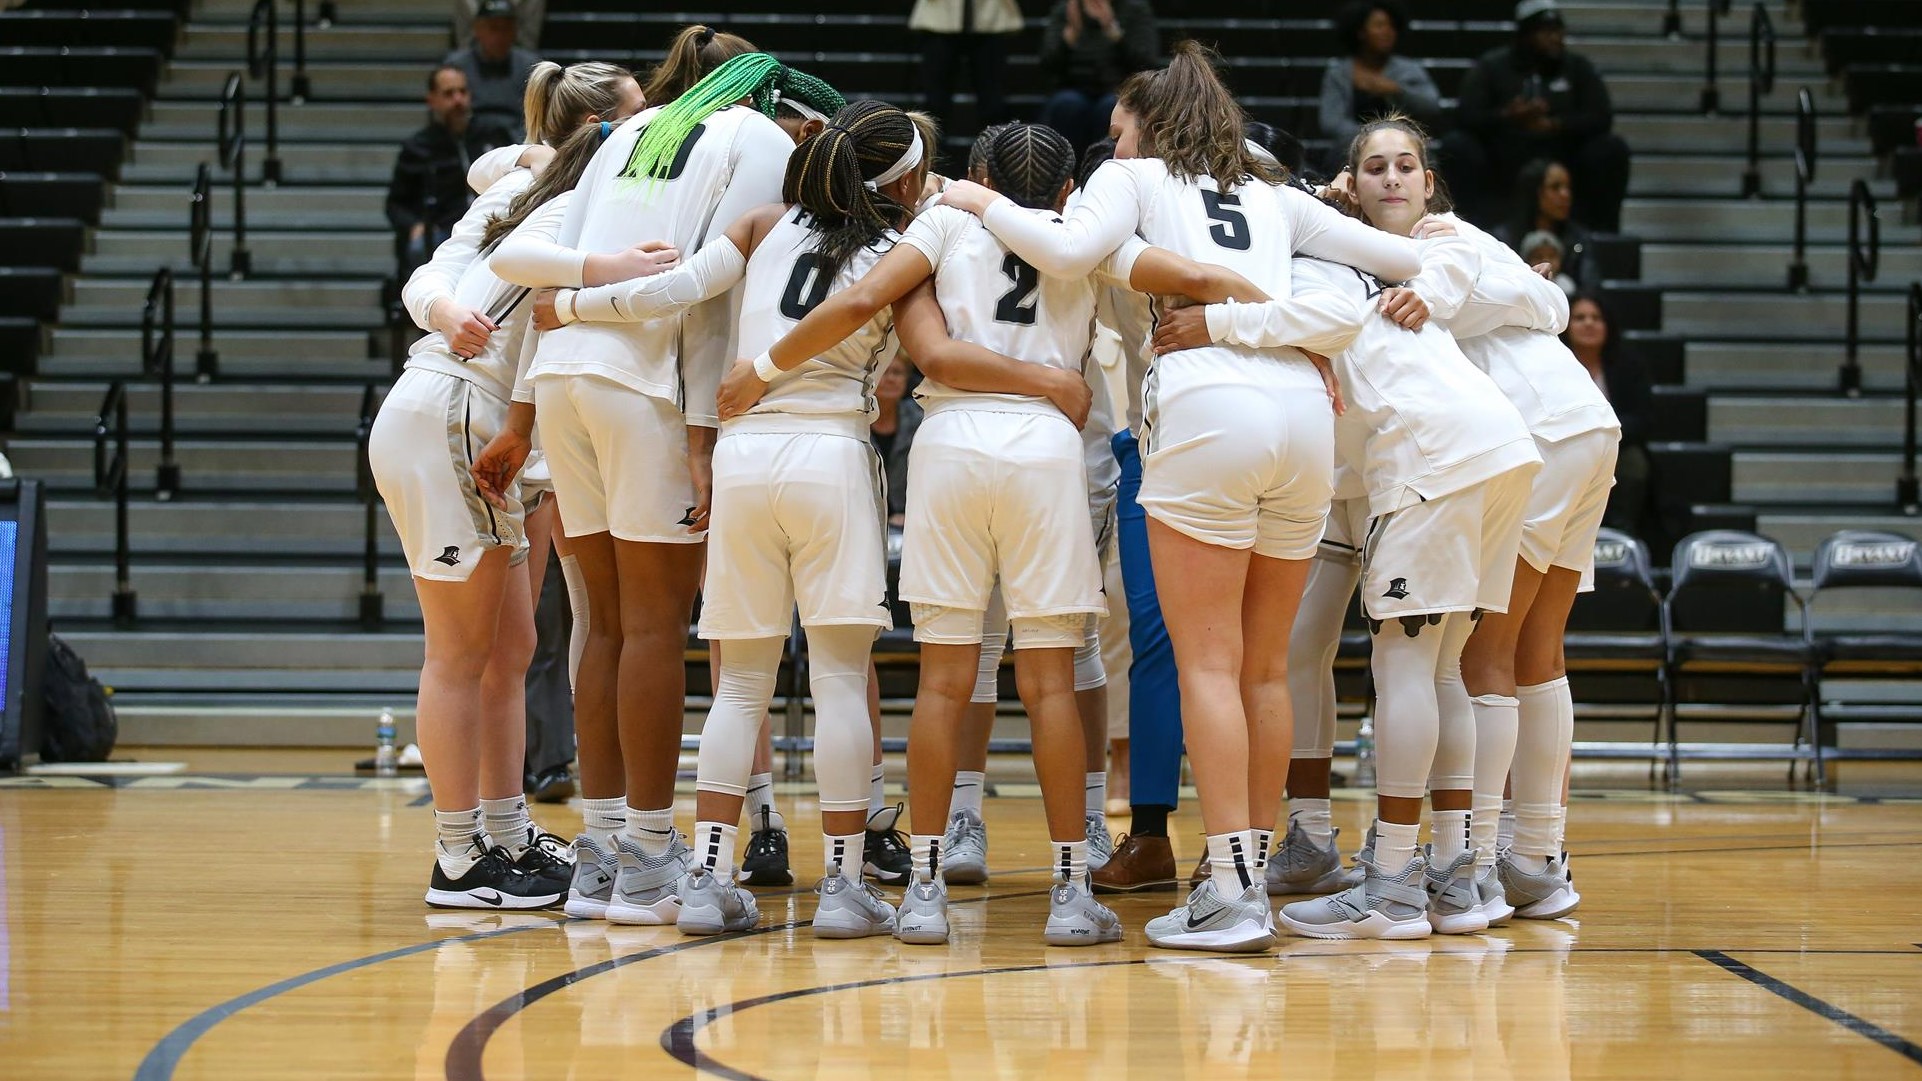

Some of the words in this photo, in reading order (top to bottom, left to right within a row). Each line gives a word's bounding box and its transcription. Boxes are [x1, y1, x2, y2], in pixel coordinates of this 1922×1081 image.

[1200, 188, 1252, 251] 5
[778, 249, 837, 321] 0
[992, 250, 1040, 327] 2
